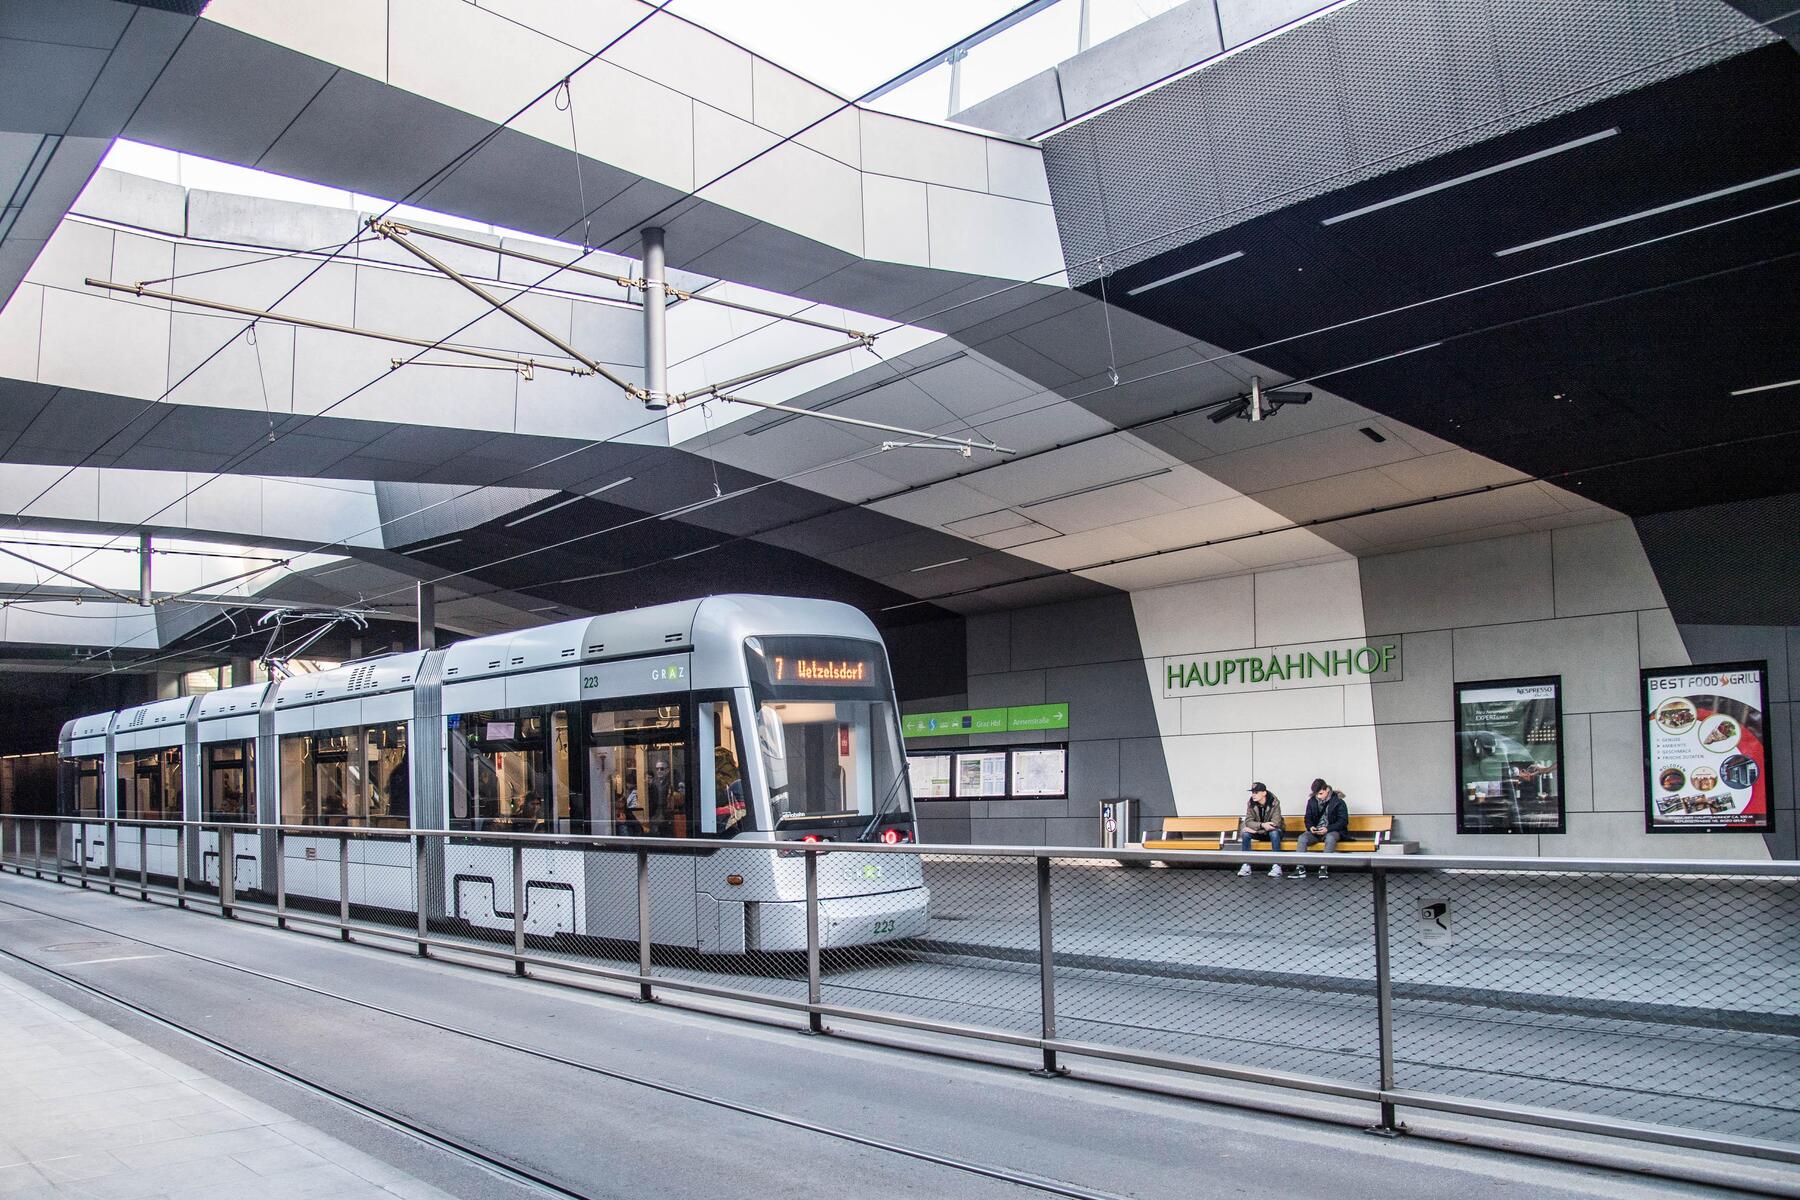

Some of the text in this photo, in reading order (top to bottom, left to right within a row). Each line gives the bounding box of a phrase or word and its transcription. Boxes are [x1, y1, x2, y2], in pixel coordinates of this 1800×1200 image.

[651, 666, 685, 681] GRAZ
[775, 657, 865, 680] 7 Wetzelsdorf
[1167, 644, 1397, 690] HAUPTBAHNHOF
[583, 675, 600, 689] 223
[1650, 672, 1761, 691] BEST FOOD GRILL
[1516, 686, 1553, 695] NESPRESSO
[1012, 716, 1050, 727] Annenstraße
[873, 919, 896, 934] 223
